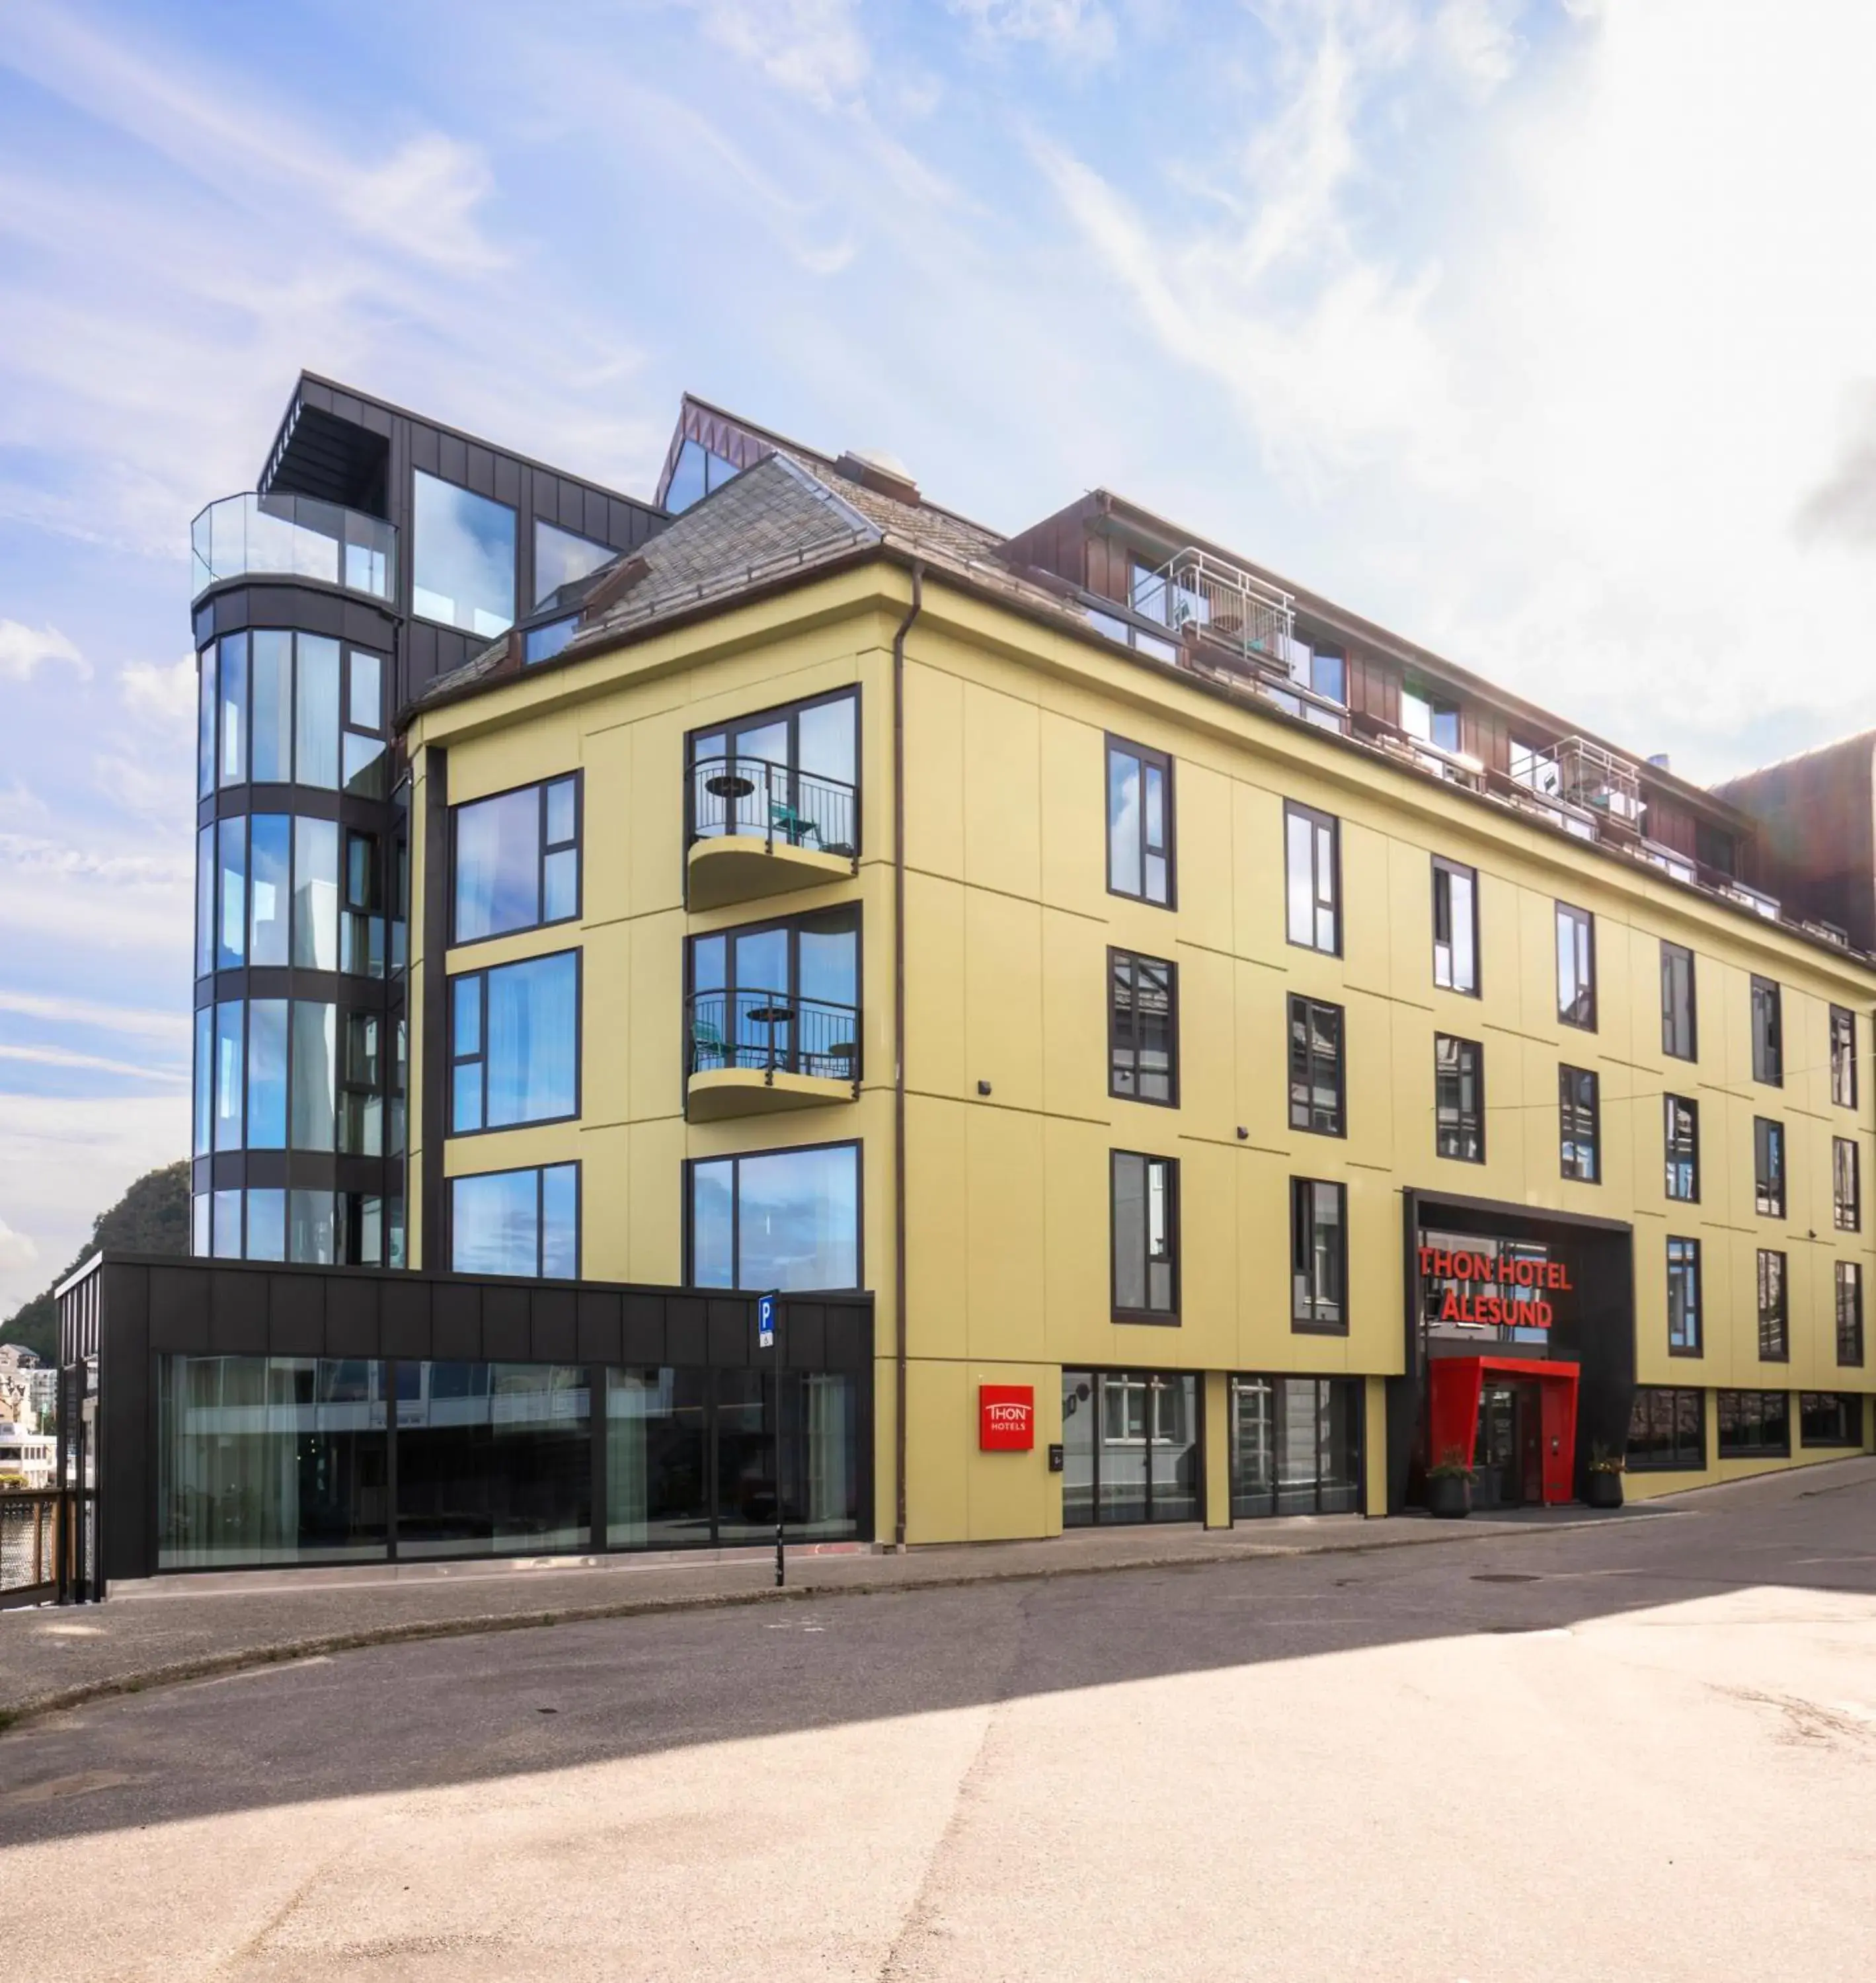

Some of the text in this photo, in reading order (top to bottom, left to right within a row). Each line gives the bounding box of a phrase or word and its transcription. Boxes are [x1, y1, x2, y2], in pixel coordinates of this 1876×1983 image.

[1419, 1247, 1573, 1290] THON HOTEL
[762, 1302, 771, 1329] P
[985, 1403, 1032, 1420] THON
[991, 1422, 1025, 1430] HOTELS
